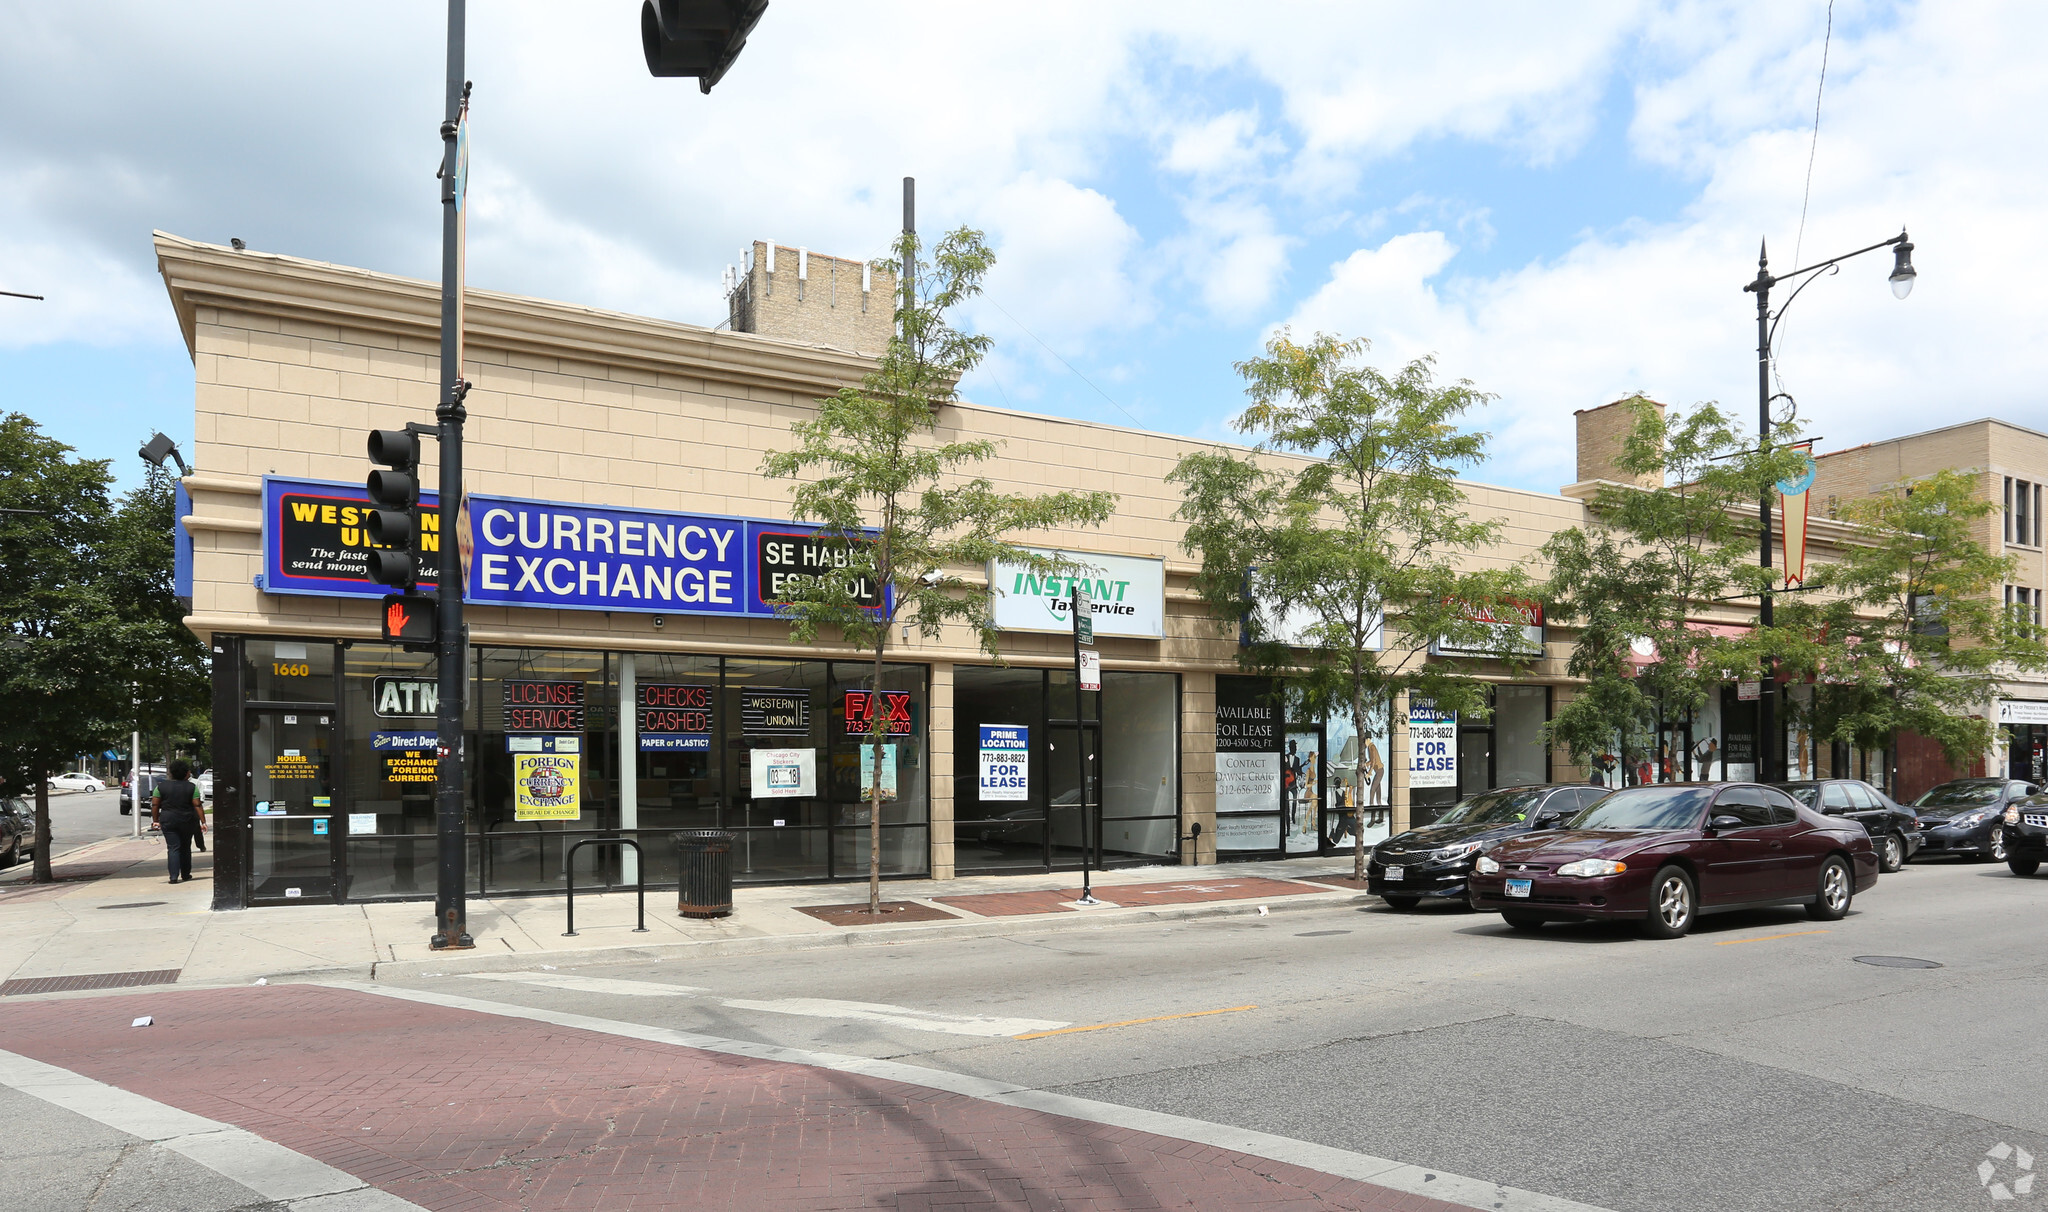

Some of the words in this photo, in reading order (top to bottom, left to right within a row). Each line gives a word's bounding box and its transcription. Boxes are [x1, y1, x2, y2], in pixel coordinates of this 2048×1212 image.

[481, 508, 735, 562] CURRENCY
[310, 547, 335, 558] The
[765, 541, 795, 565] SE
[291, 560, 323, 570] send
[481, 553, 733, 604] EXCHANGE
[1012, 572, 1130, 602] INSTANT
[1091, 602, 1135, 616] ervice
[272, 662, 309, 677] 1660
[378, 681, 439, 714] ATM
[511, 684, 576, 704] LICENSE
[645, 686, 706, 707] CHECKS
[751, 698, 795, 709] WESTERN
[845, 693, 911, 720] FAX
[512, 709, 577, 729] SERVICE
[645, 711, 706, 731] CASHED
[766, 715, 795, 726] UNION
[990, 730, 1018, 740] PRIME
[1216, 723, 1239, 736] FOR
[1242, 723, 1273, 737] LEASE
[1409, 727, 1454, 739] 773-883-8822
[373, 737, 391, 748] Better
[392, 736, 418, 747] Direct
[544, 740, 553, 748] or
[641, 739, 666, 747] PAPER
[675, 739, 709, 748] PLASTIC?
[981, 739, 1026, 749] LOCATION
[1215, 738, 1249, 747] 1200-4500
[1416, 742, 1446, 756] FOR
[520, 757, 575, 770] FOREIGN
[982, 753, 1026, 763] 773-883-8822
[1226, 758, 1266, 768] CONTACT
[1409, 757, 1454, 771] LEASE
[770, 769, 780, 784] 03
[789, 768, 797, 783] 18
[989, 765, 1019, 776] FOR
[1215, 771, 1246, 782] DAWNE
[388, 774, 438, 782] CURRENCY
[519, 778, 575, 787] CURRENCY
[981, 777, 1027, 788] LEASE
[1219, 785, 1272, 795] 312-656-3028
[519, 794, 576, 807] EXCHANGE
